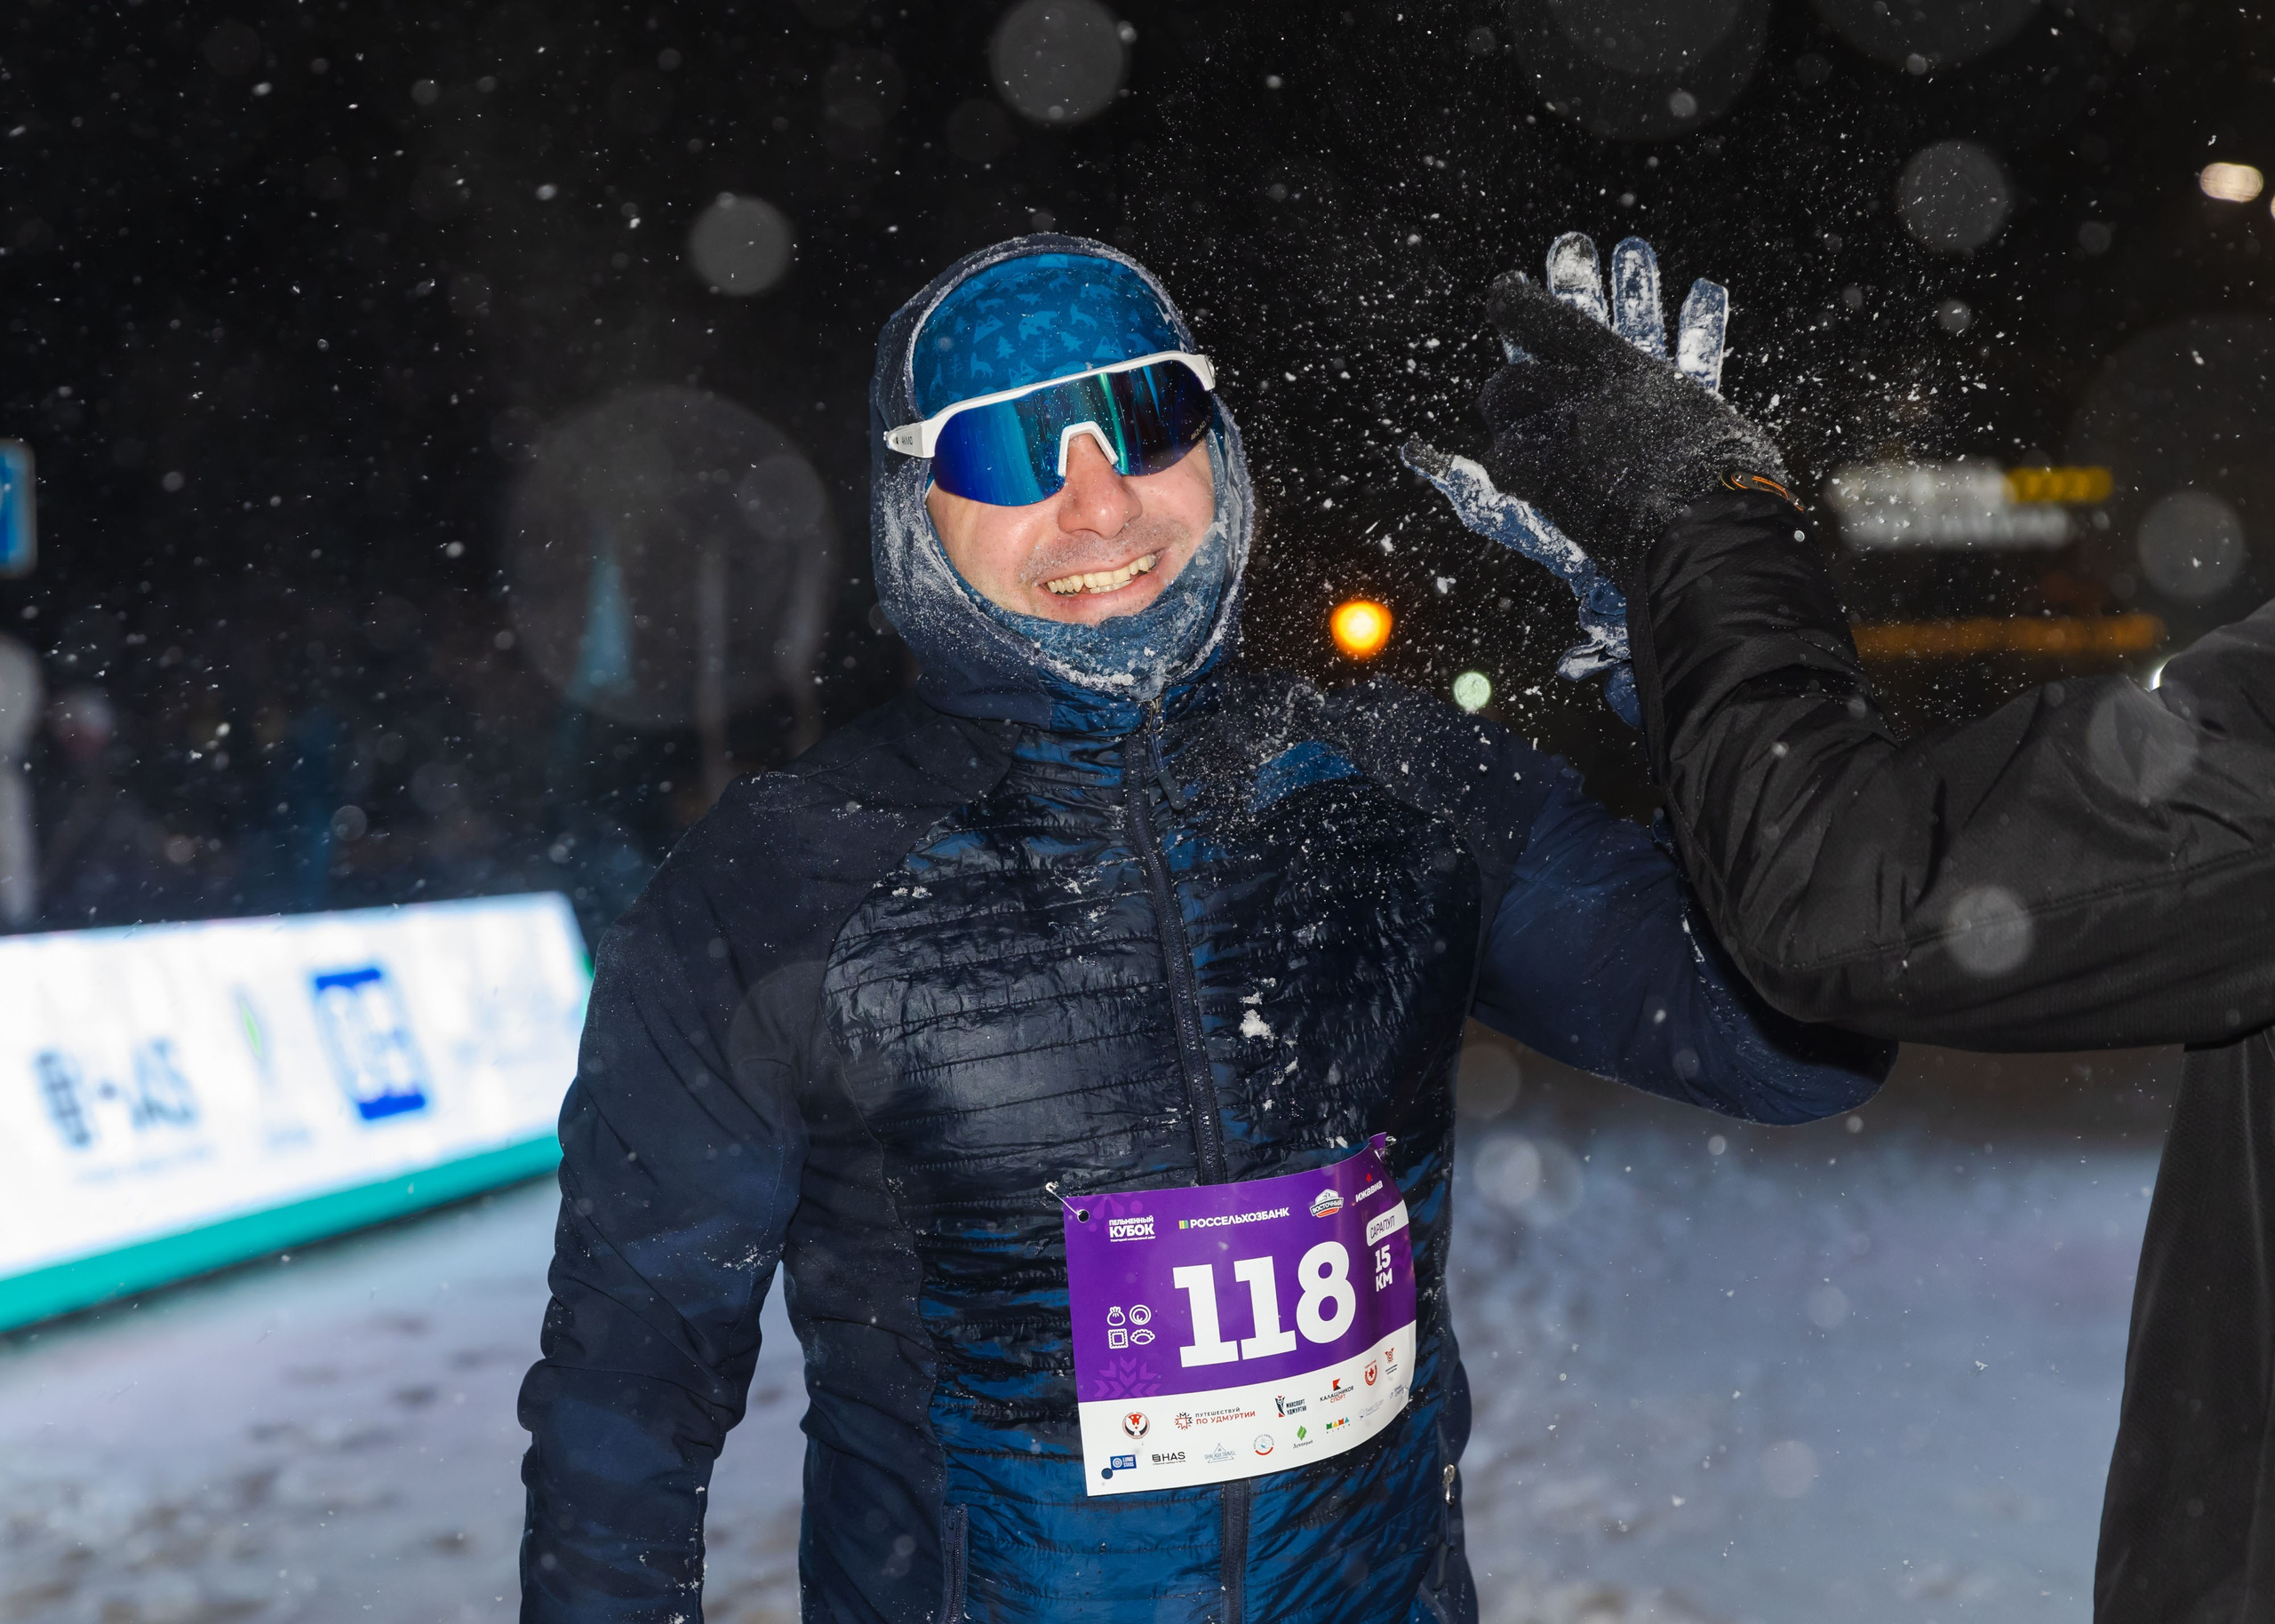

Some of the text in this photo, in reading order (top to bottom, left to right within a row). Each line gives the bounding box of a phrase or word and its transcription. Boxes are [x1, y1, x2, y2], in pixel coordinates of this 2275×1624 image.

[1108, 1215, 1154, 1226] ПЕЛЬМЕННЫЙ
[1190, 1207, 1290, 1228] РОССЕЛЬХОЗБАНК
[1109, 1224, 1155, 1238] КУБОК
[1375, 1244, 1392, 1273] 15
[1375, 1268, 1393, 1293] КМ
[1172, 1241, 1356, 1368] 118
[1320, 1386, 1354, 1402] КАЛАШНИКОВ
[1329, 1394, 1345, 1404] СПОРТ
[1195, 1407, 1241, 1418] ПУТЕШЕСТВУЙ
[1210, 1411, 1256, 1424] УДМУРТИИ
[1161, 1452, 1185, 1462] HAS
